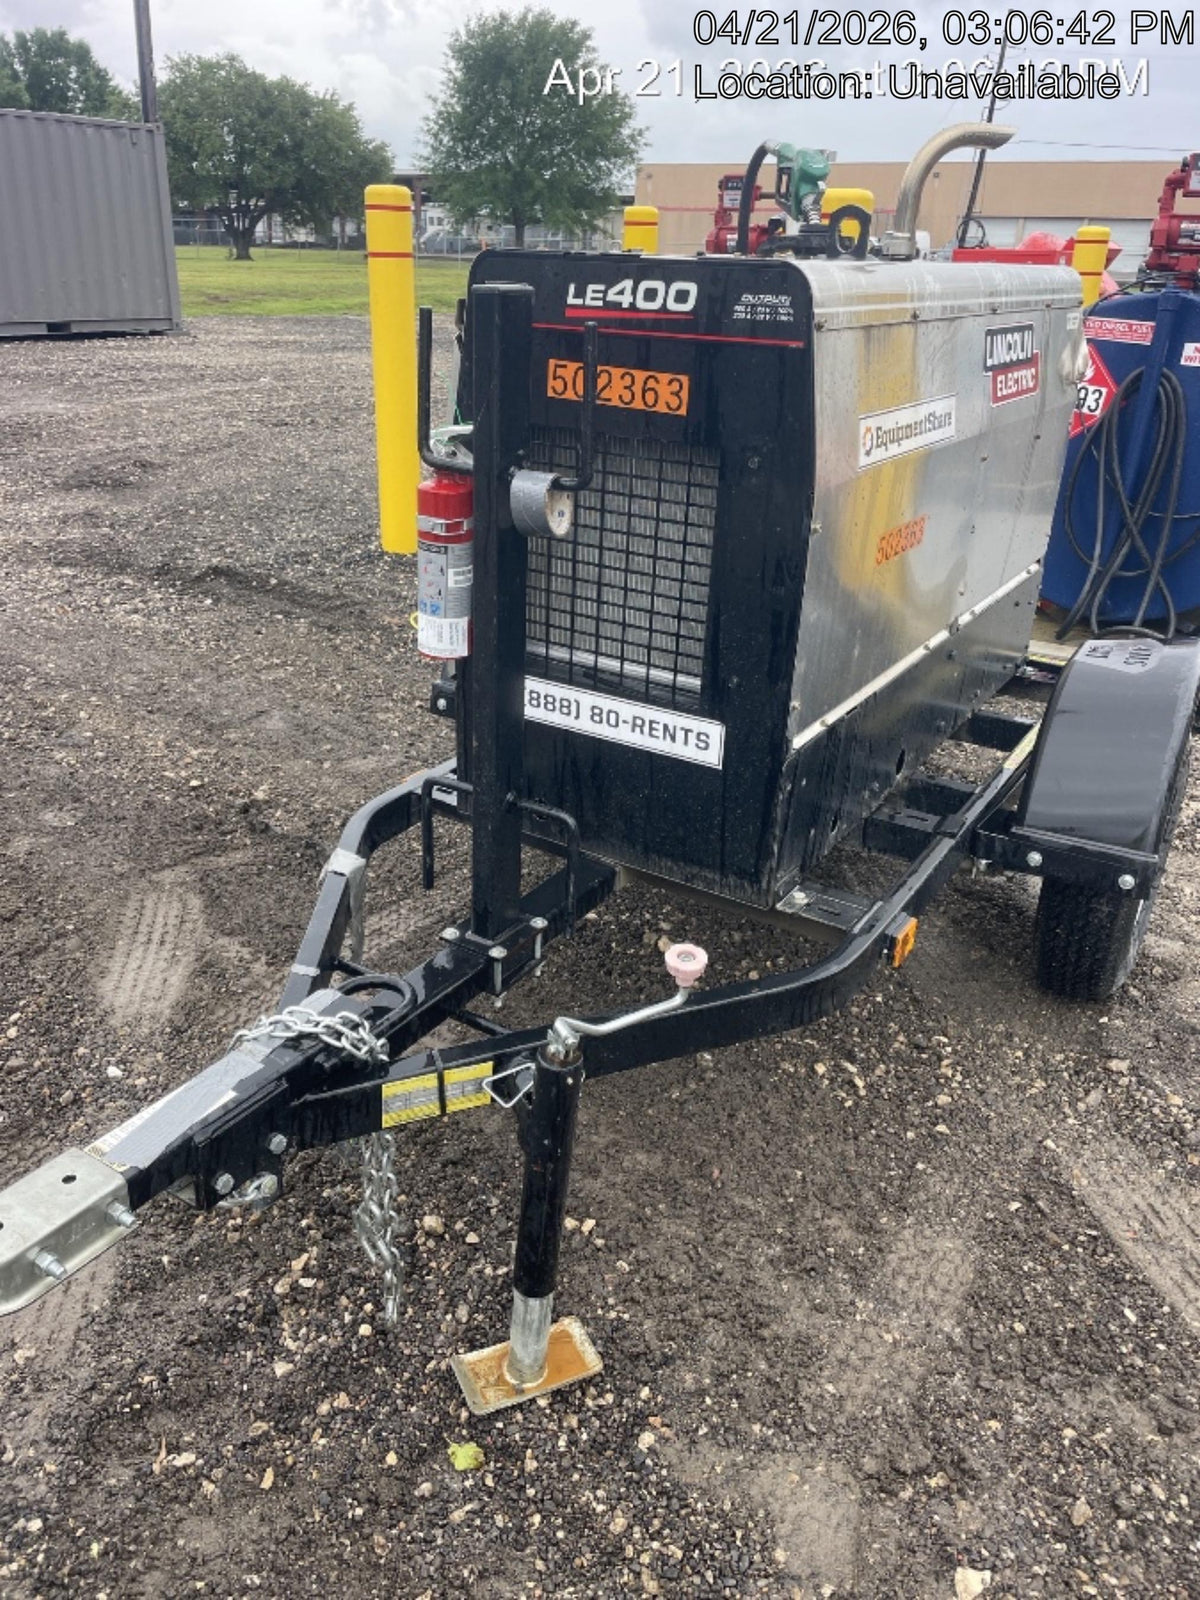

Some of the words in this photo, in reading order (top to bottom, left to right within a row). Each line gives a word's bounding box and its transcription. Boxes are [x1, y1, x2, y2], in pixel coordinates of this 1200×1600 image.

[567, 279, 698, 312] LE400
[986, 330, 1032, 367] LINCOLN
[551, 363, 684, 412] 502363
[996, 367, 1036, 398] ELECTRIC
[875, 409, 953, 451] EquipmentShare
[526, 688, 581, 720] 888)
[589, 705, 711, 751] 80-RENTS
